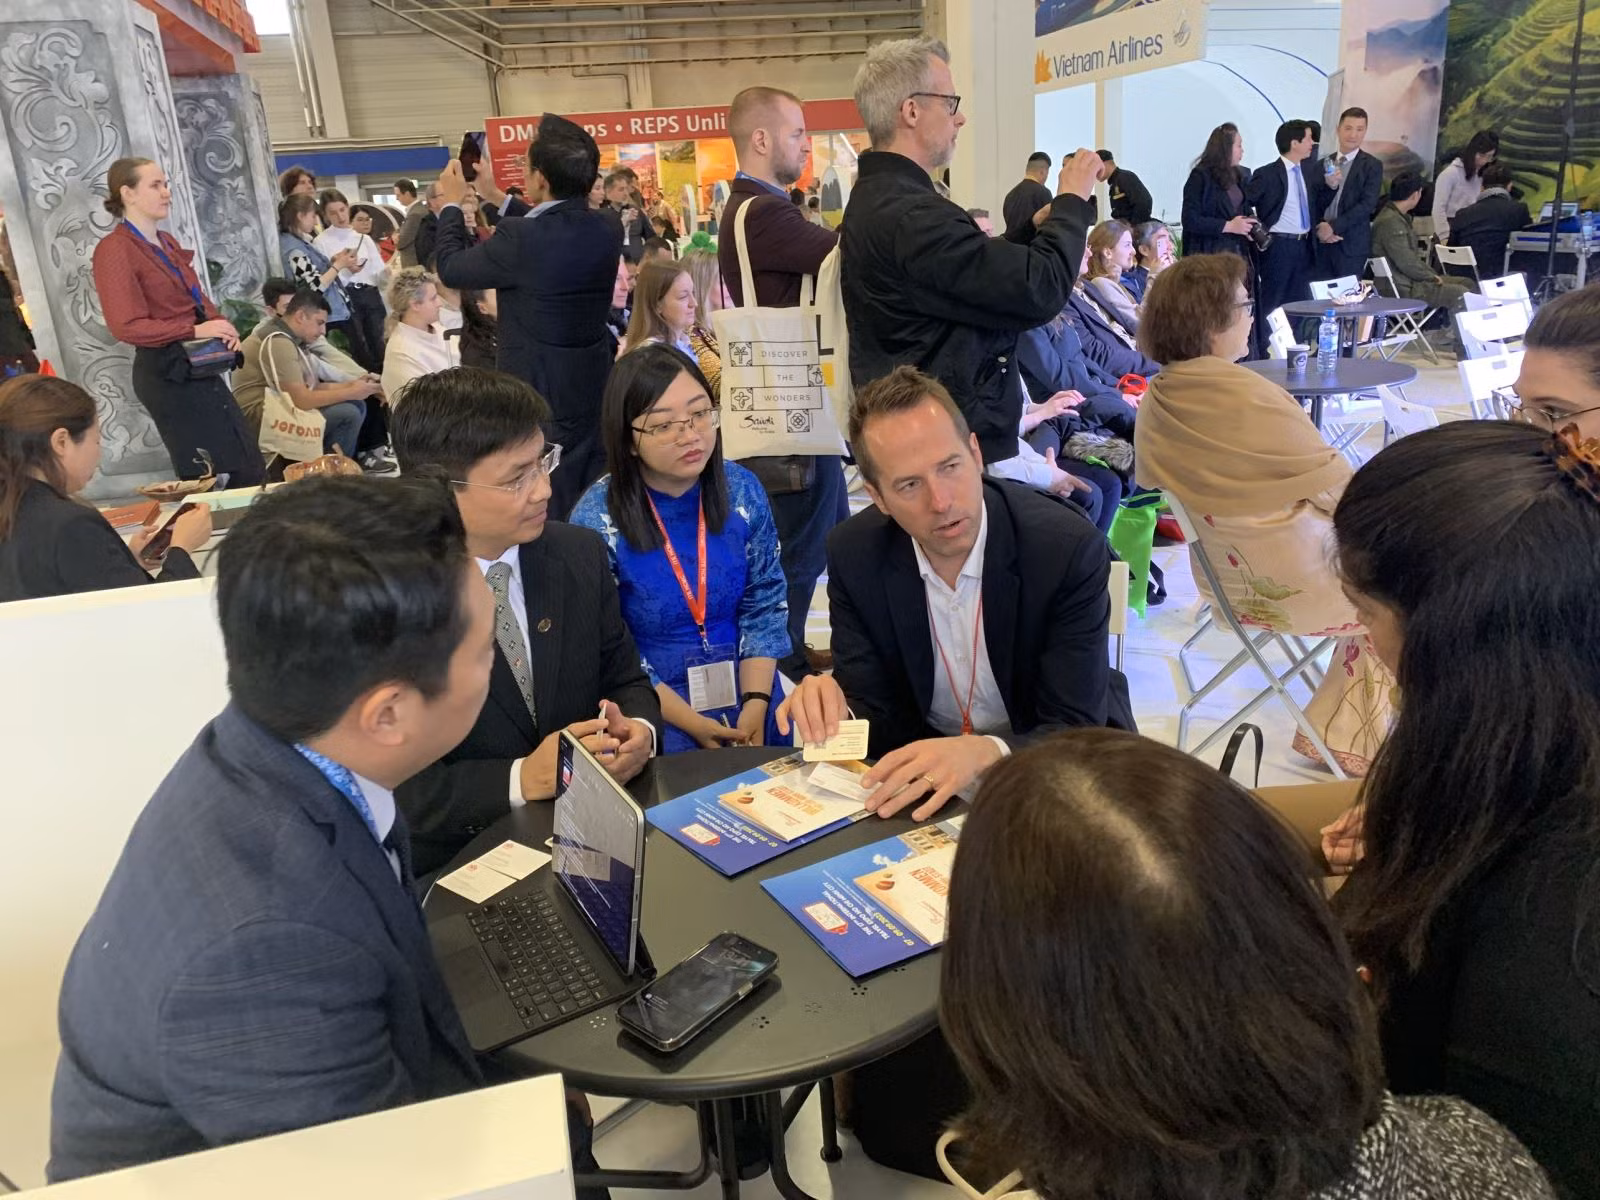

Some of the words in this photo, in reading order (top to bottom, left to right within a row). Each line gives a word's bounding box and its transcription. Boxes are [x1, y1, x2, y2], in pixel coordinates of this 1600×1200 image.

[1053, 50, 1104, 79] Vietnam
[1107, 33, 1163, 67] Airlines
[499, 124, 538, 143] DM
[630, 116, 679, 136] REPS
[761, 350, 808, 359] DISCOVER
[763, 394, 811, 402] WONDERS
